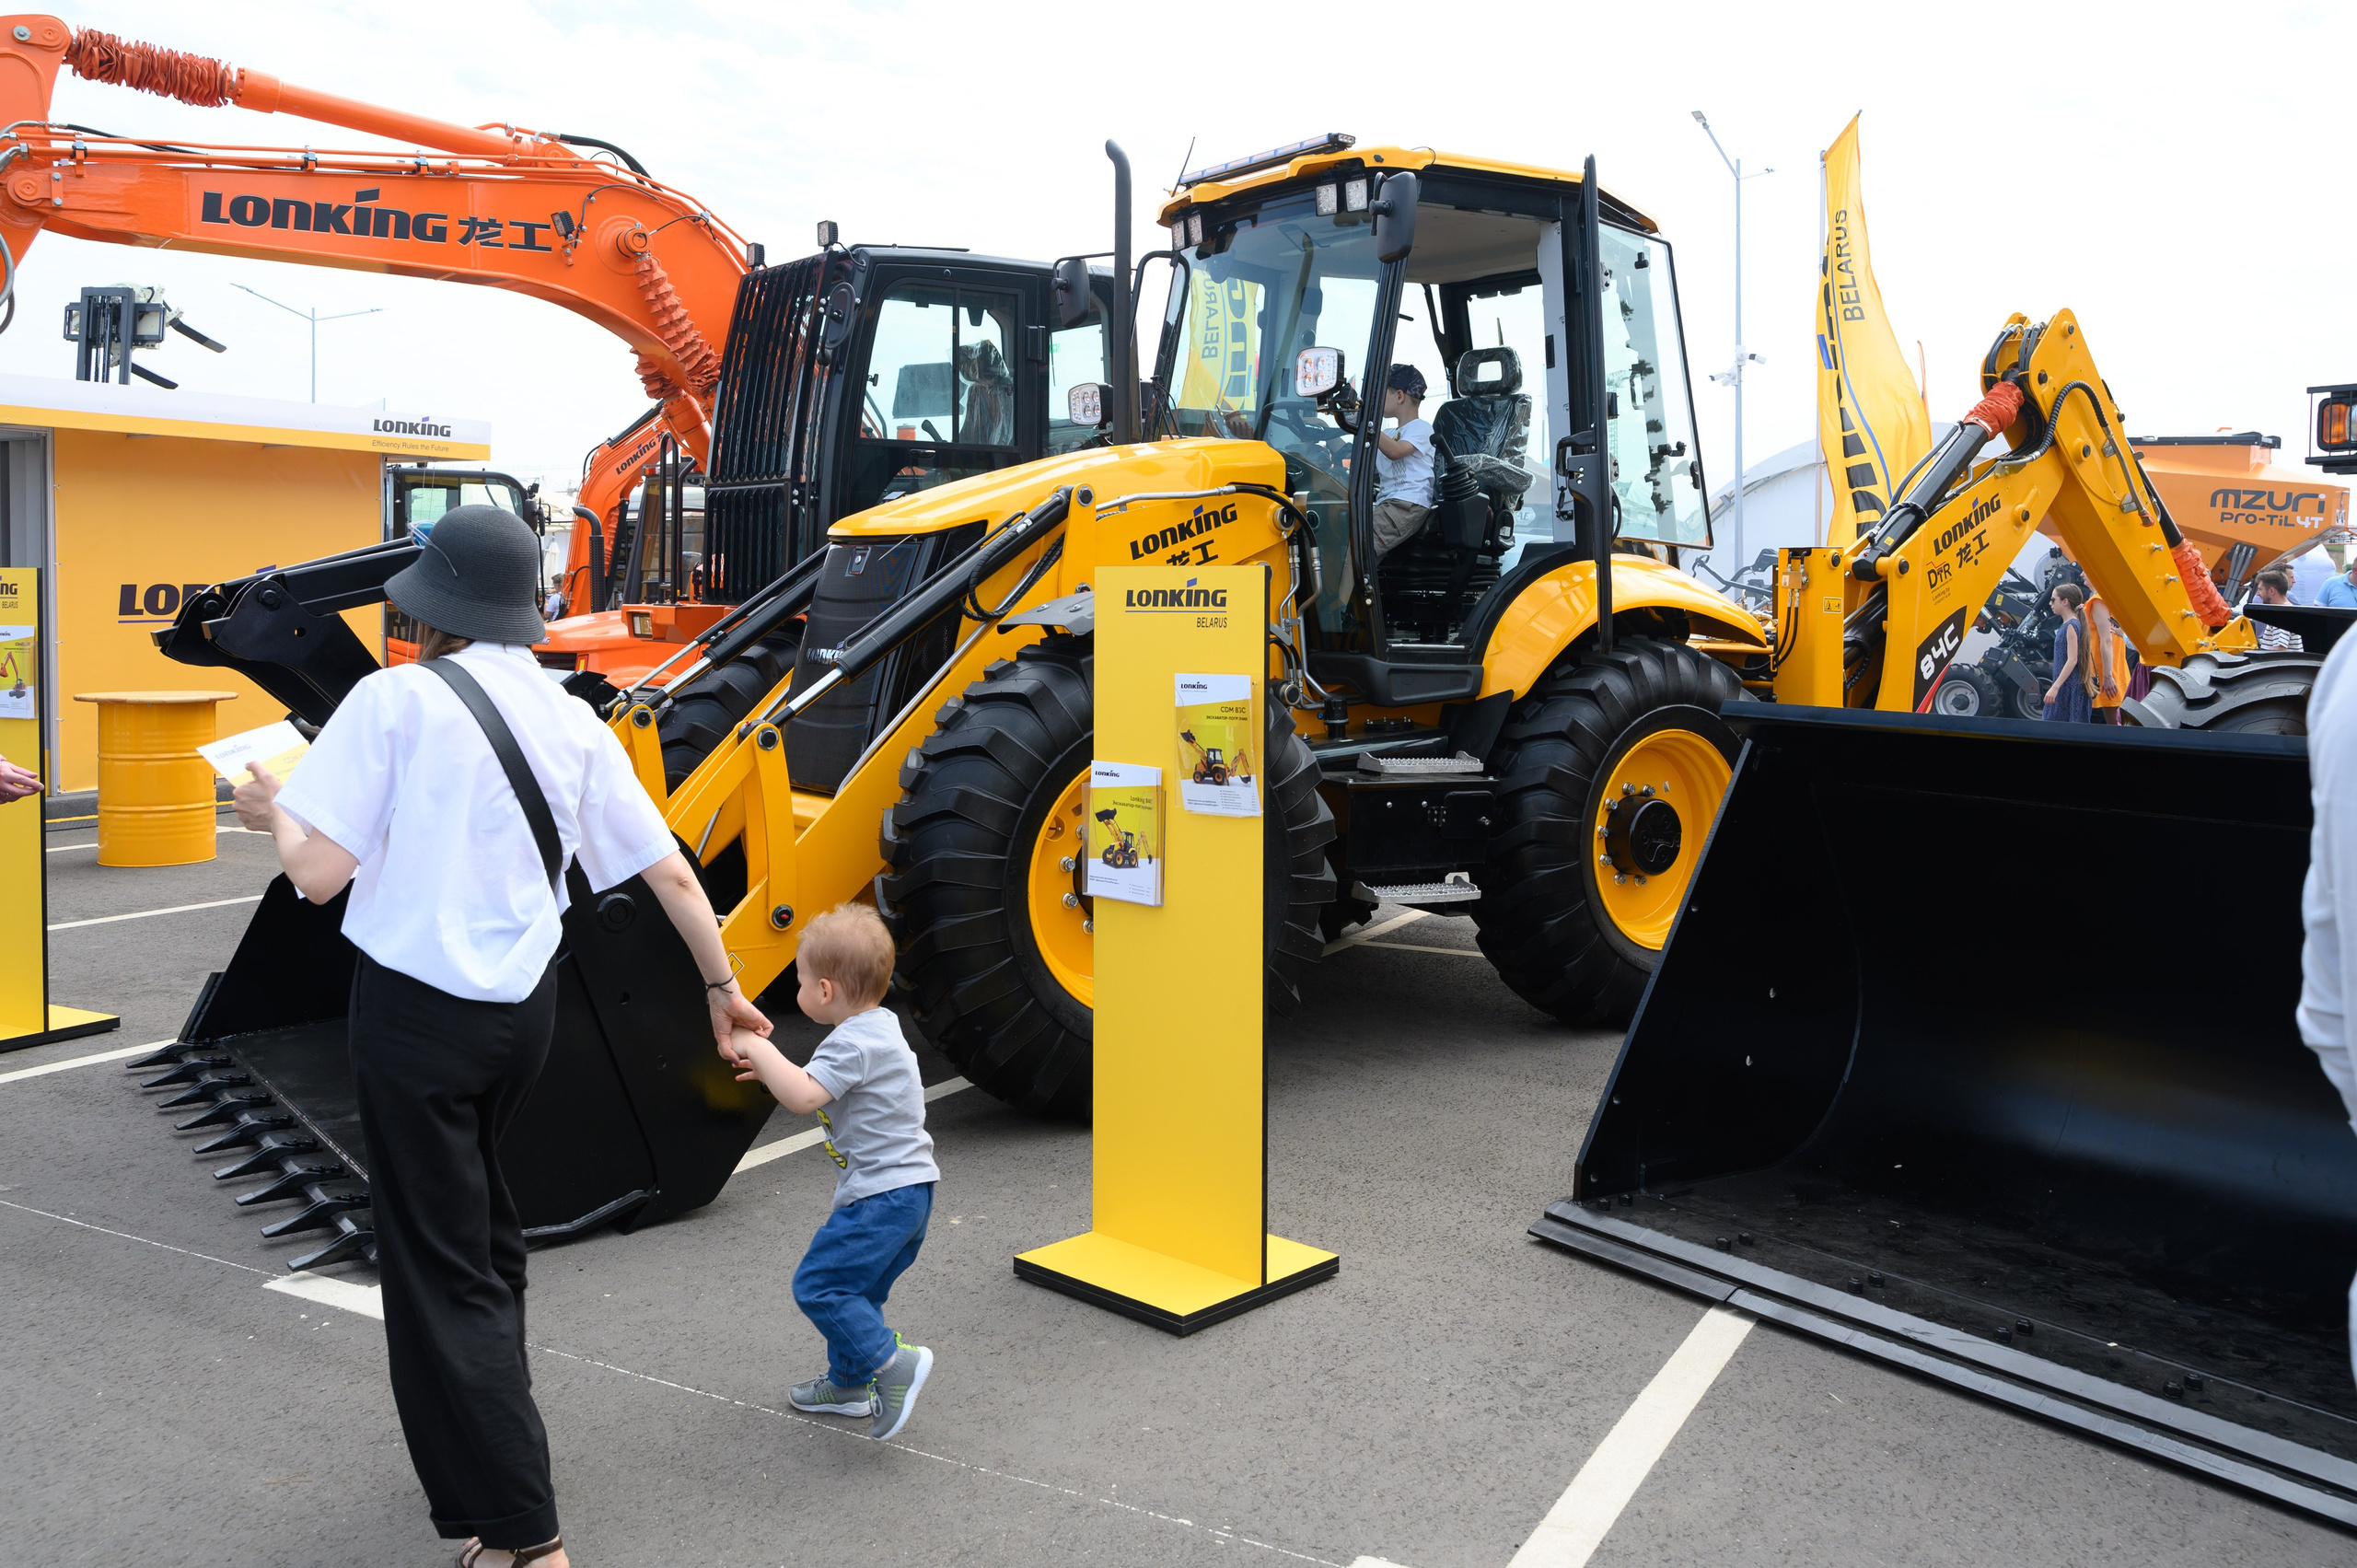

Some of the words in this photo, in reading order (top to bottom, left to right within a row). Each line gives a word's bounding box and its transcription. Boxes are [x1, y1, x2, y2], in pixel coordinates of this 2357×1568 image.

[457, 215, 552, 252] 龙工
[1835, 209, 1865, 321] BELARUS
[372, 439, 401, 449] Efficiency
[420, 443, 430, 451] the
[431, 444, 449, 452] Future
[2, 600, 18, 609] BELARUS
[1196, 617, 1228, 628] BELARUS
[1920, 622, 1959, 680] 84C
